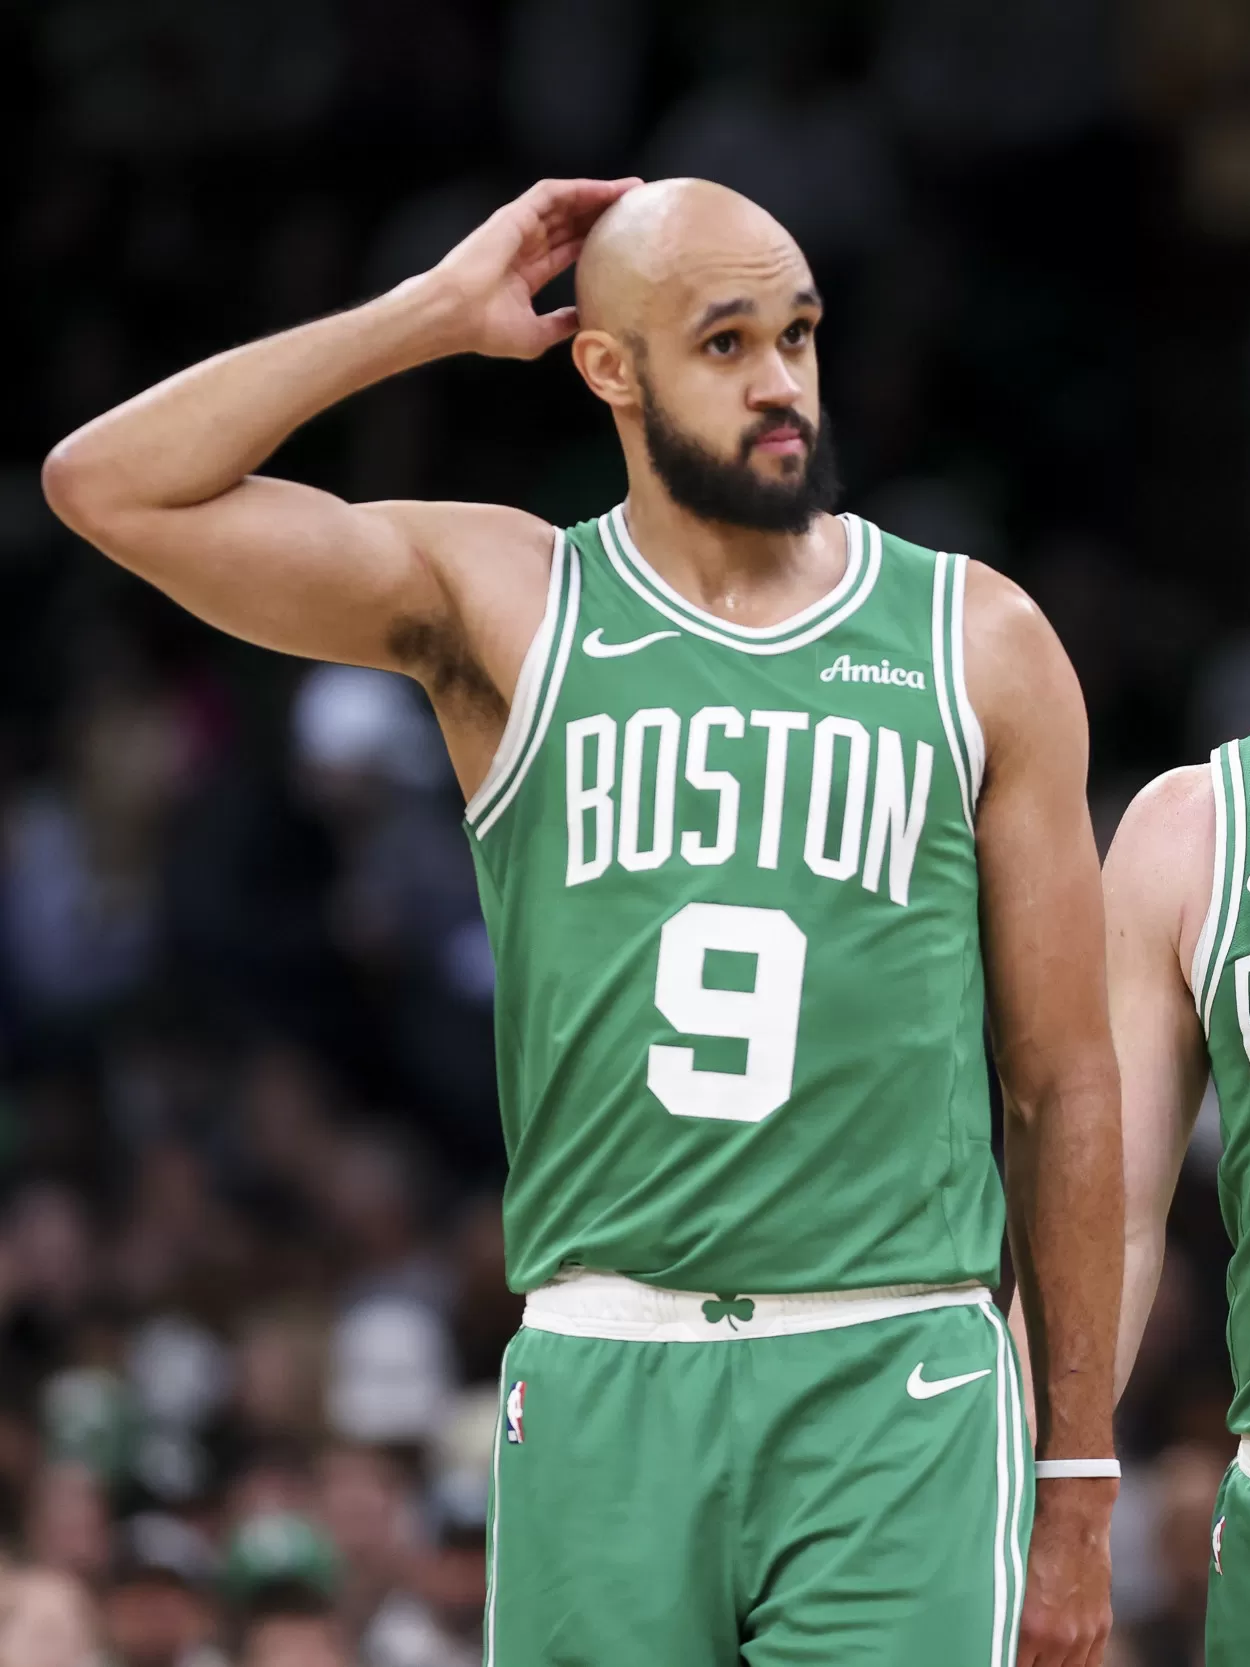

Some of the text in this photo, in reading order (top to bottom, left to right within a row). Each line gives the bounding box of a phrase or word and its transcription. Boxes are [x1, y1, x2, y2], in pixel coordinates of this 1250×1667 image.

[820, 654, 926, 690] Amica
[565, 706, 934, 907] BOSTON
[646, 902, 807, 1122] 9
